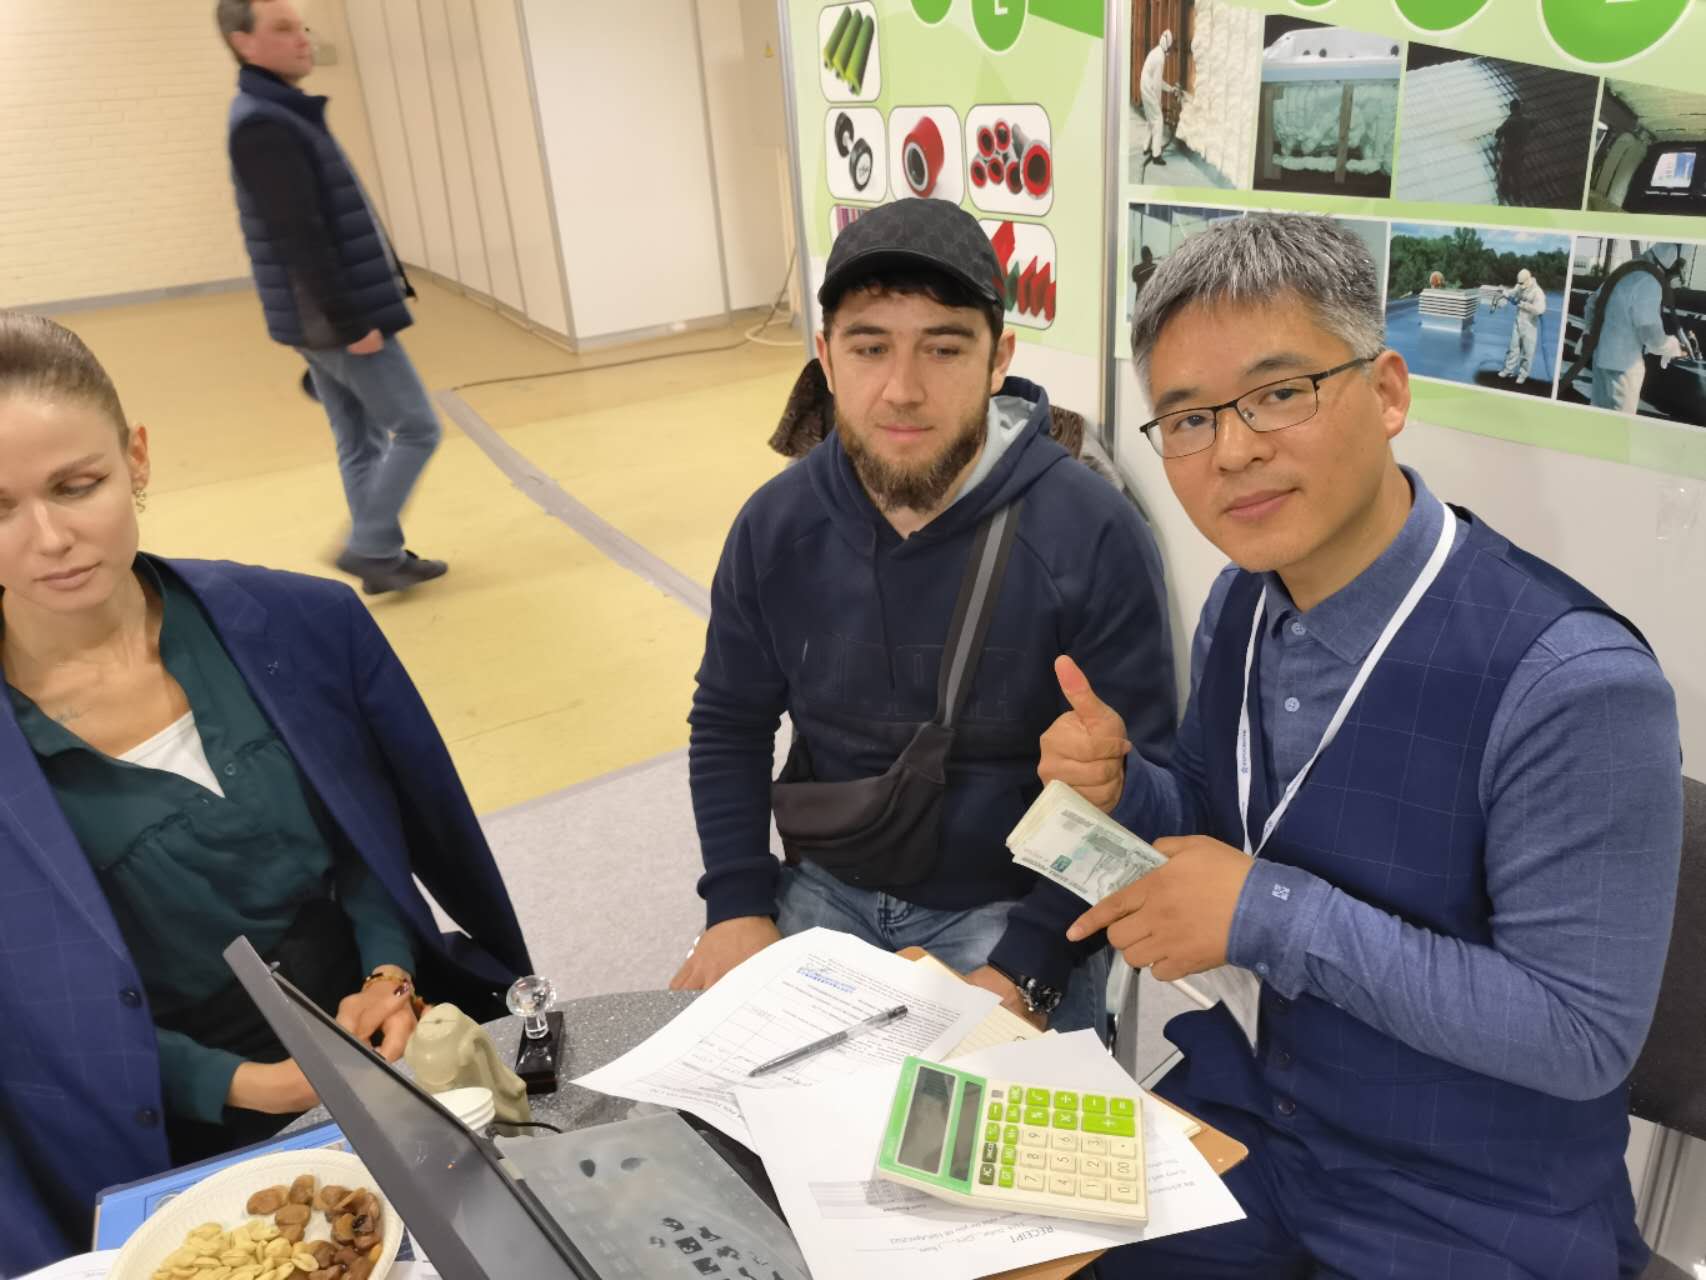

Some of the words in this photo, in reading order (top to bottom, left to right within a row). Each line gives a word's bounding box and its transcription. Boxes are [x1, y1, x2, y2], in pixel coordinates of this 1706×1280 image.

[1029, 1131, 1041, 1139] 9
[1060, 1136, 1072, 1144] 6
[1087, 1139, 1101, 1147] 3
[1057, 1156, 1070, 1164] 5
[1087, 1160, 1100, 1168] 2
[1117, 1161, 1131, 1175] 00
[1024, 1175, 1038, 1184] 7
[1118, 1186, 1131, 1195] 0
[1009, 1224, 1055, 1244] RECEIPT
